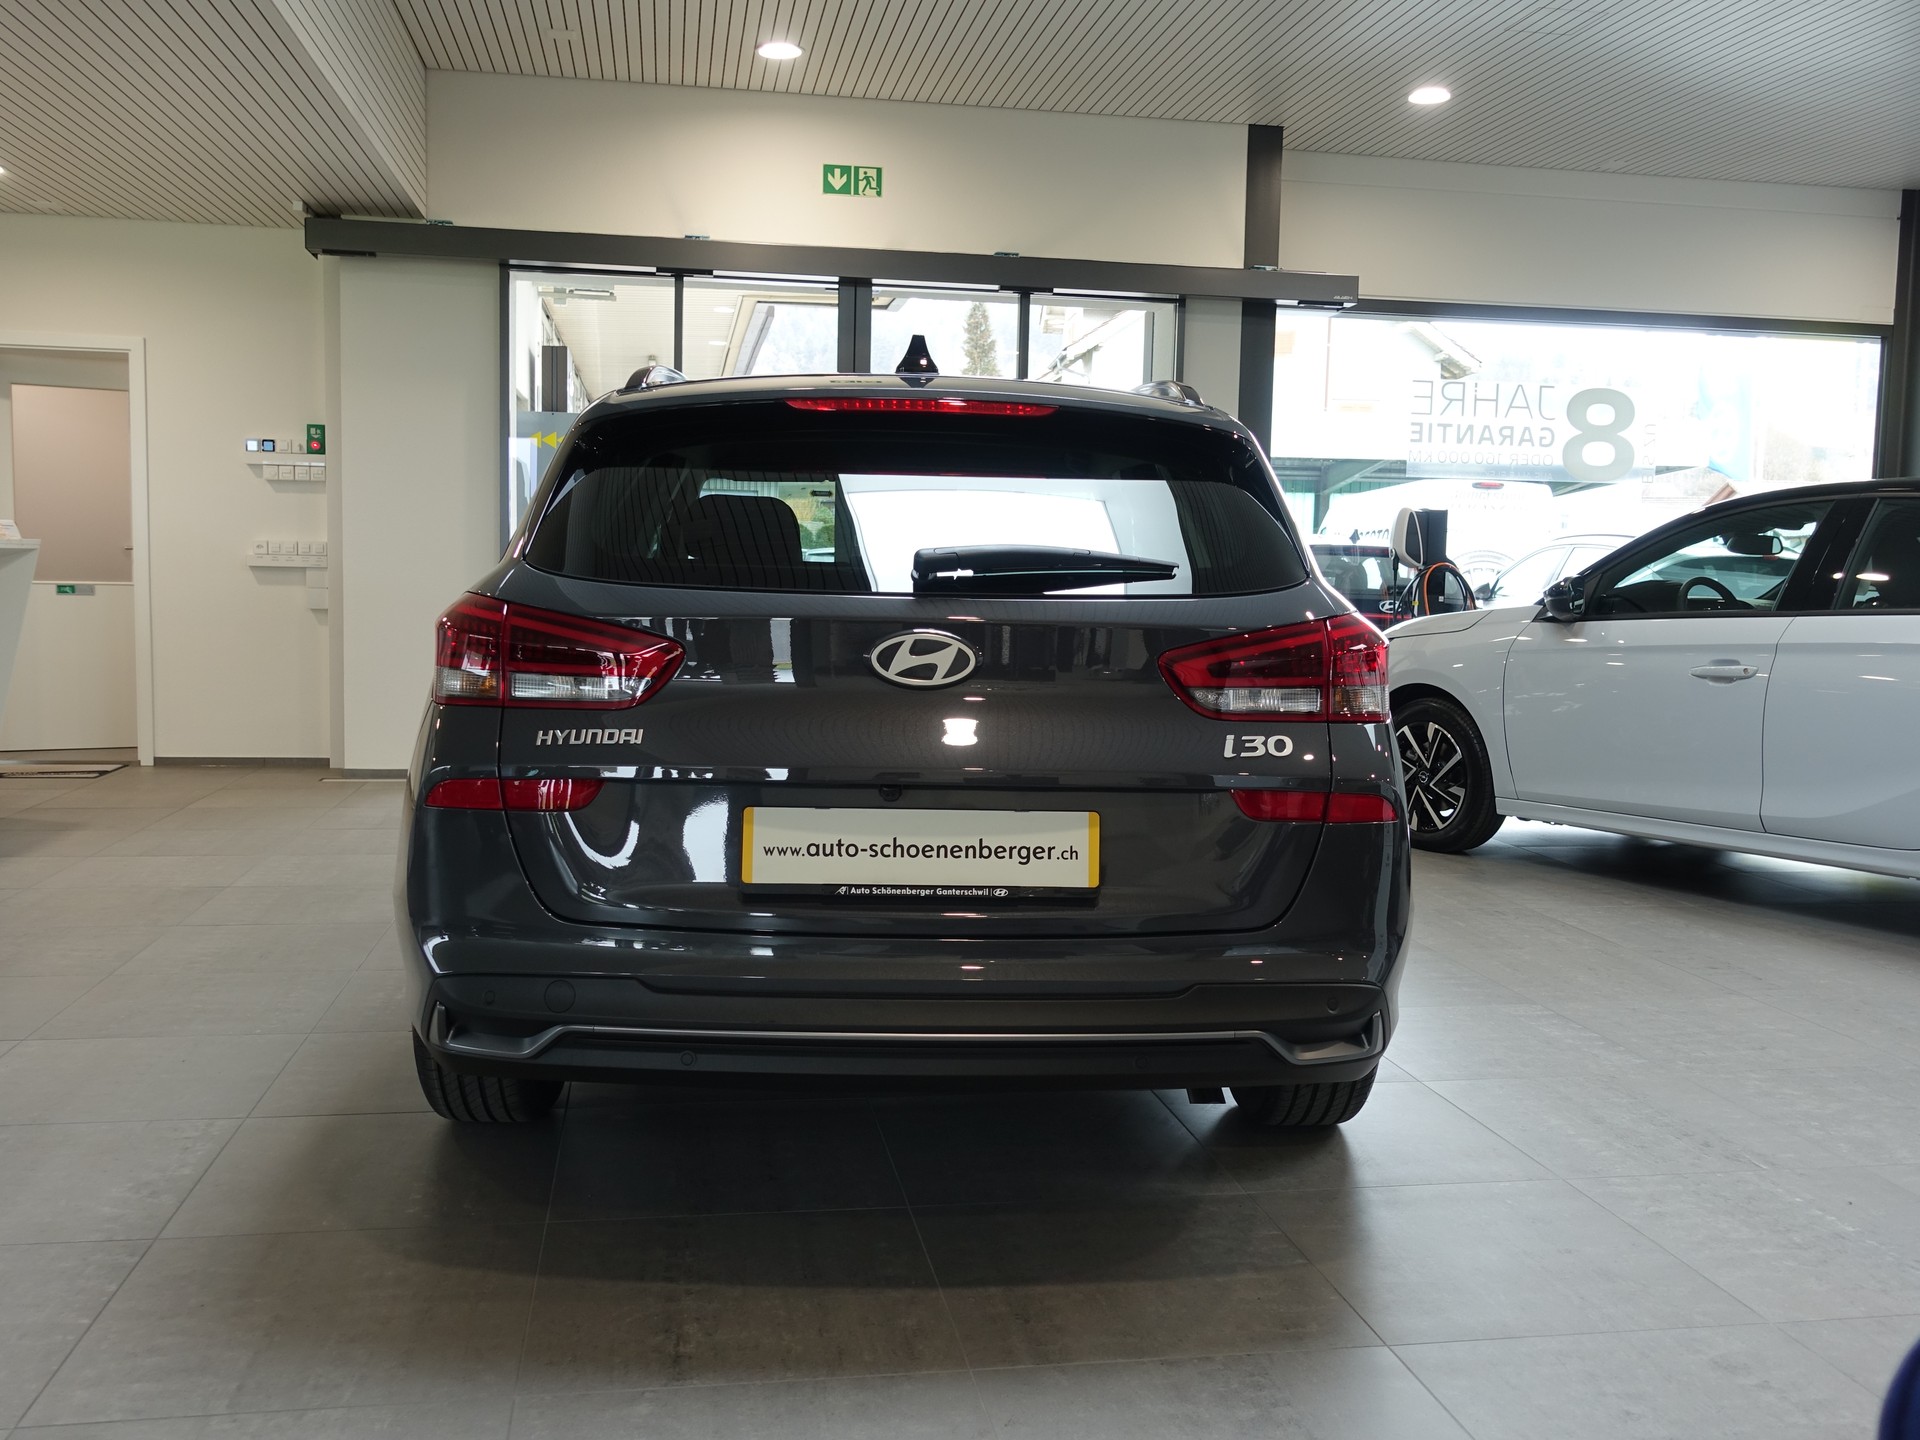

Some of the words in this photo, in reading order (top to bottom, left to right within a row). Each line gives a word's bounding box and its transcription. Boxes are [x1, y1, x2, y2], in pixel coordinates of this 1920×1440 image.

[536, 728, 644, 746] HYUNDAI
[1223, 734, 1294, 758] i30
[763, 836, 1079, 866] www.auto-schoenenberger.ch
[850, 886, 870, 895] Auto
[872, 886, 934, 897] Schönenberger
[936, 887, 989, 896] Ganterschwil
